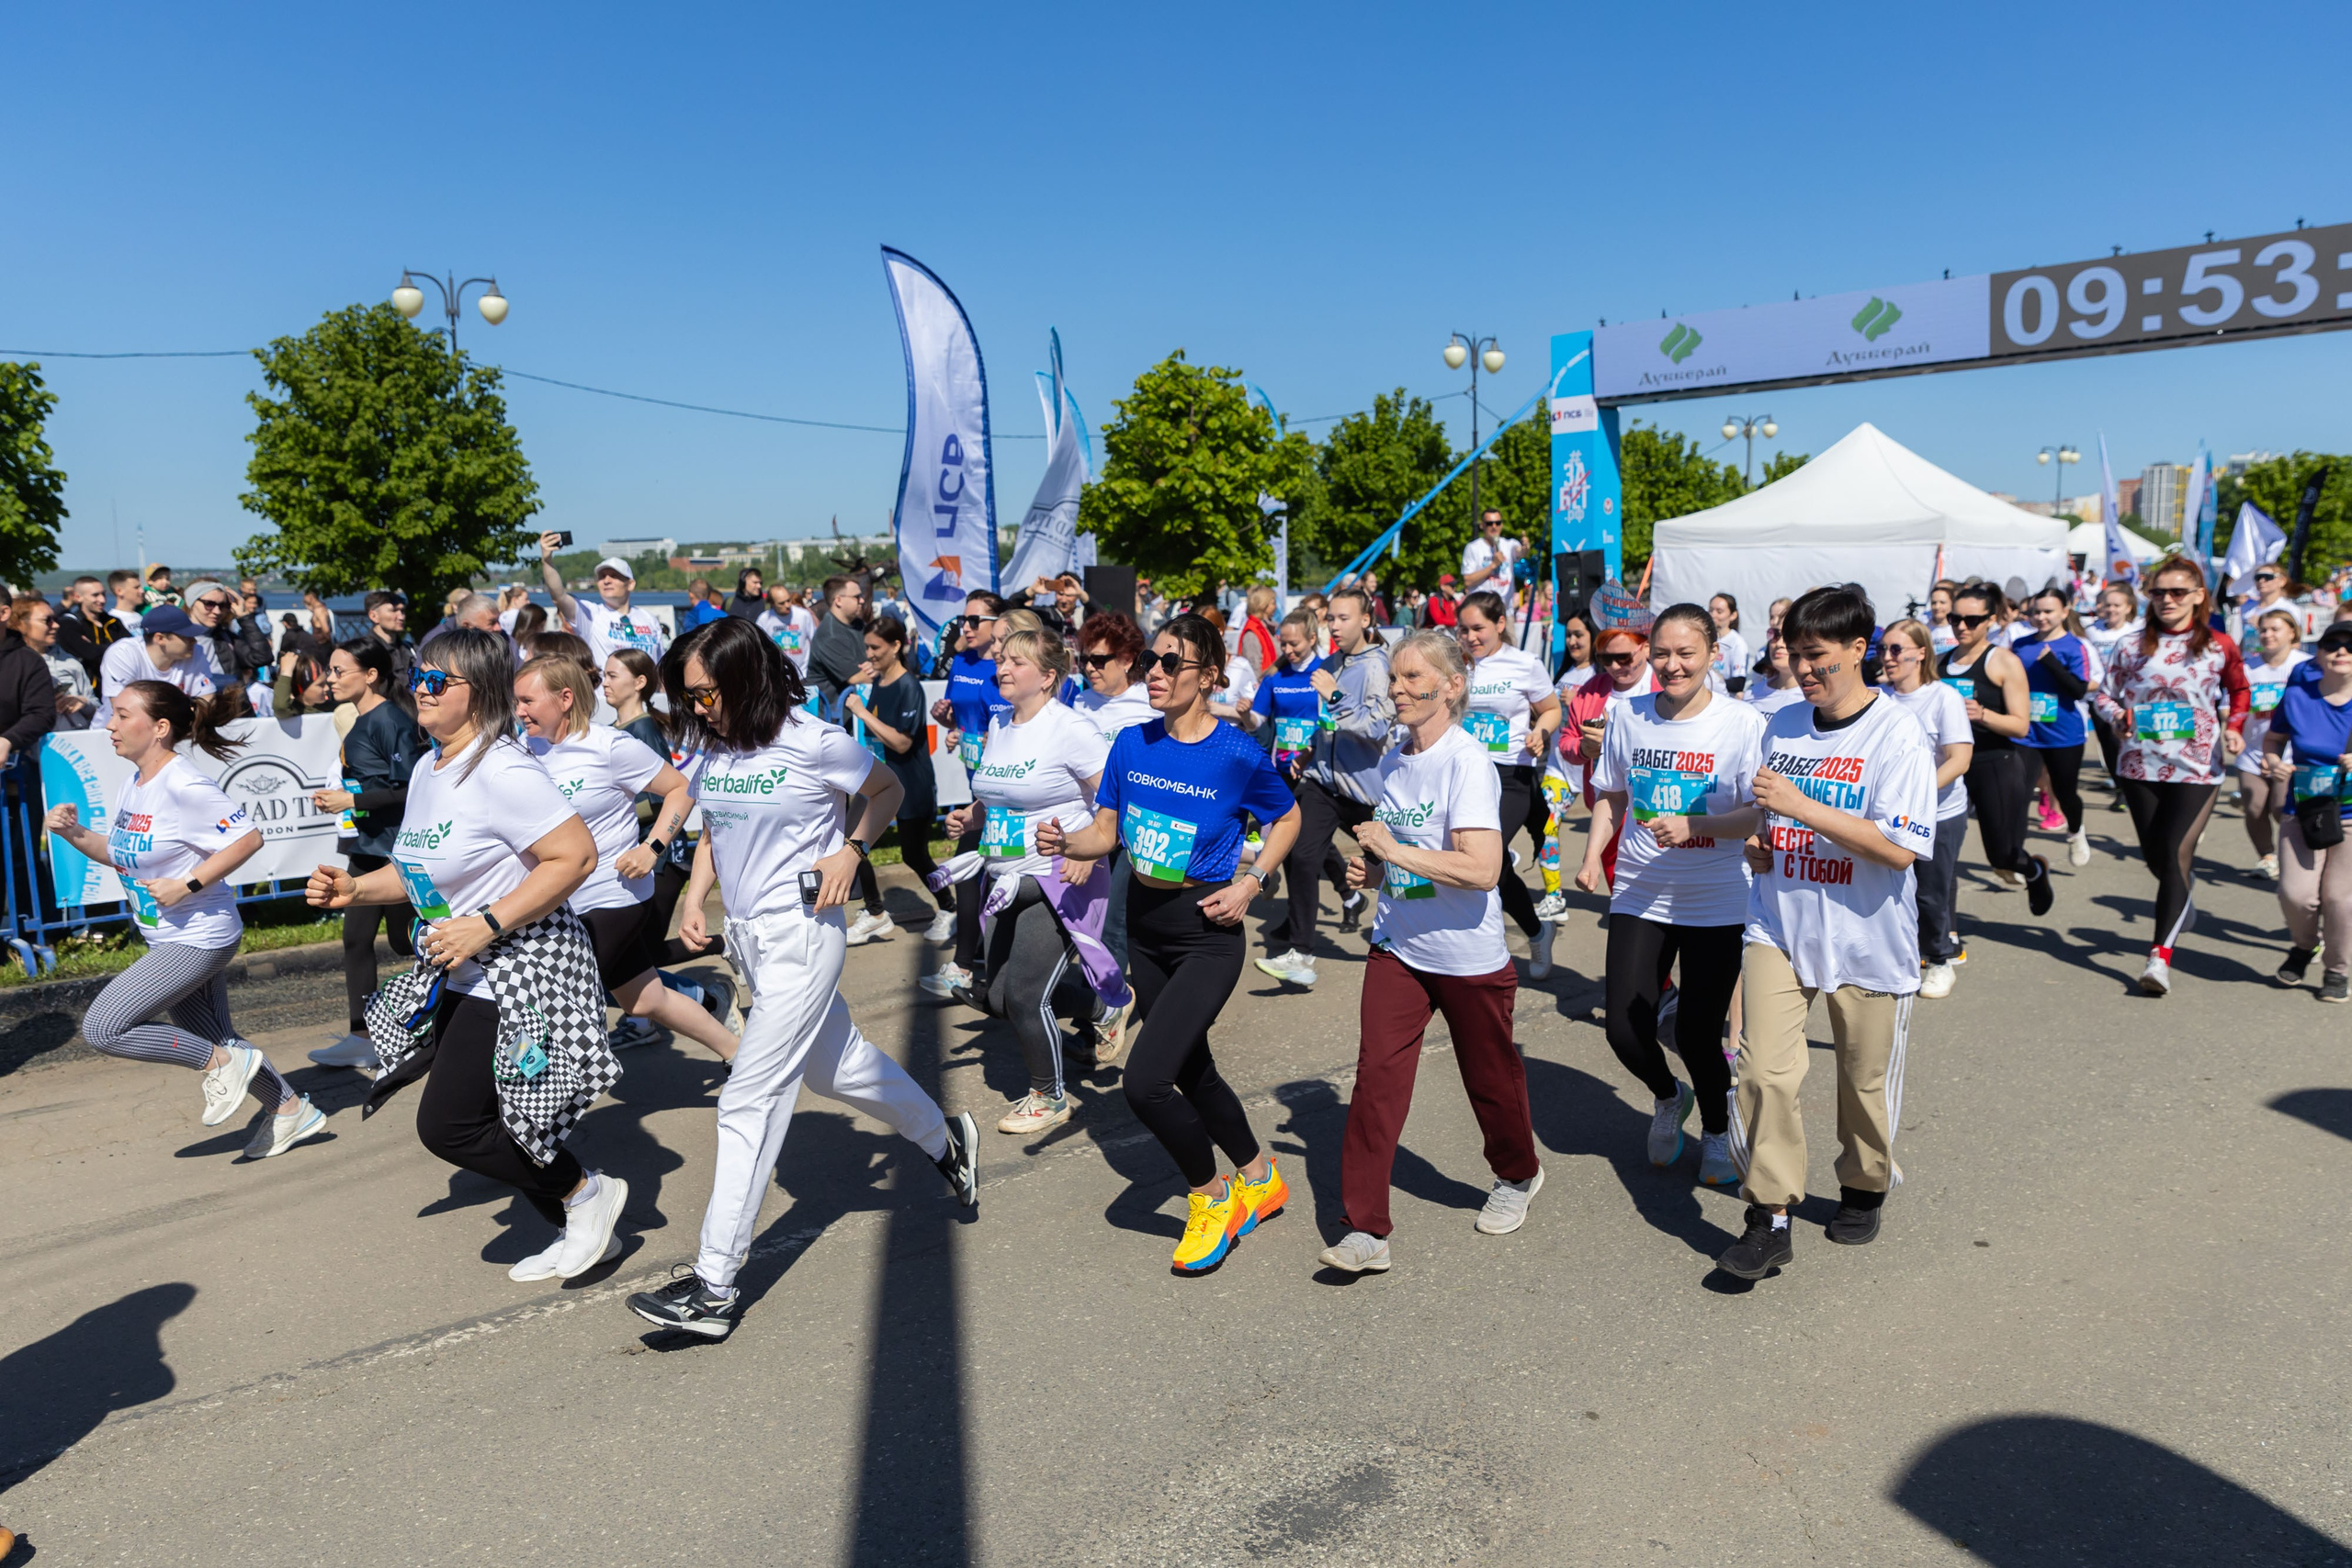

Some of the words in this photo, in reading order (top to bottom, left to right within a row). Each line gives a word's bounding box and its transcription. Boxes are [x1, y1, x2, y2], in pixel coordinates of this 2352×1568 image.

[1473, 722, 1495, 742] 374
[1632, 749, 1715, 773] #ЗАБЕГ2025
[1767, 751, 1864, 784] #ЗАБЕГ2025
[700, 772, 774, 795] Herbalife
[1127, 771, 1218, 800] СОВКОМБАНК
[1651, 784, 1682, 810] 418
[1907, 821, 1930, 839] ПСБ
[1133, 825, 1170, 863] 392
[1783, 856, 1794, 878] С
[1799, 857, 1854, 886] ТОБОЙ
